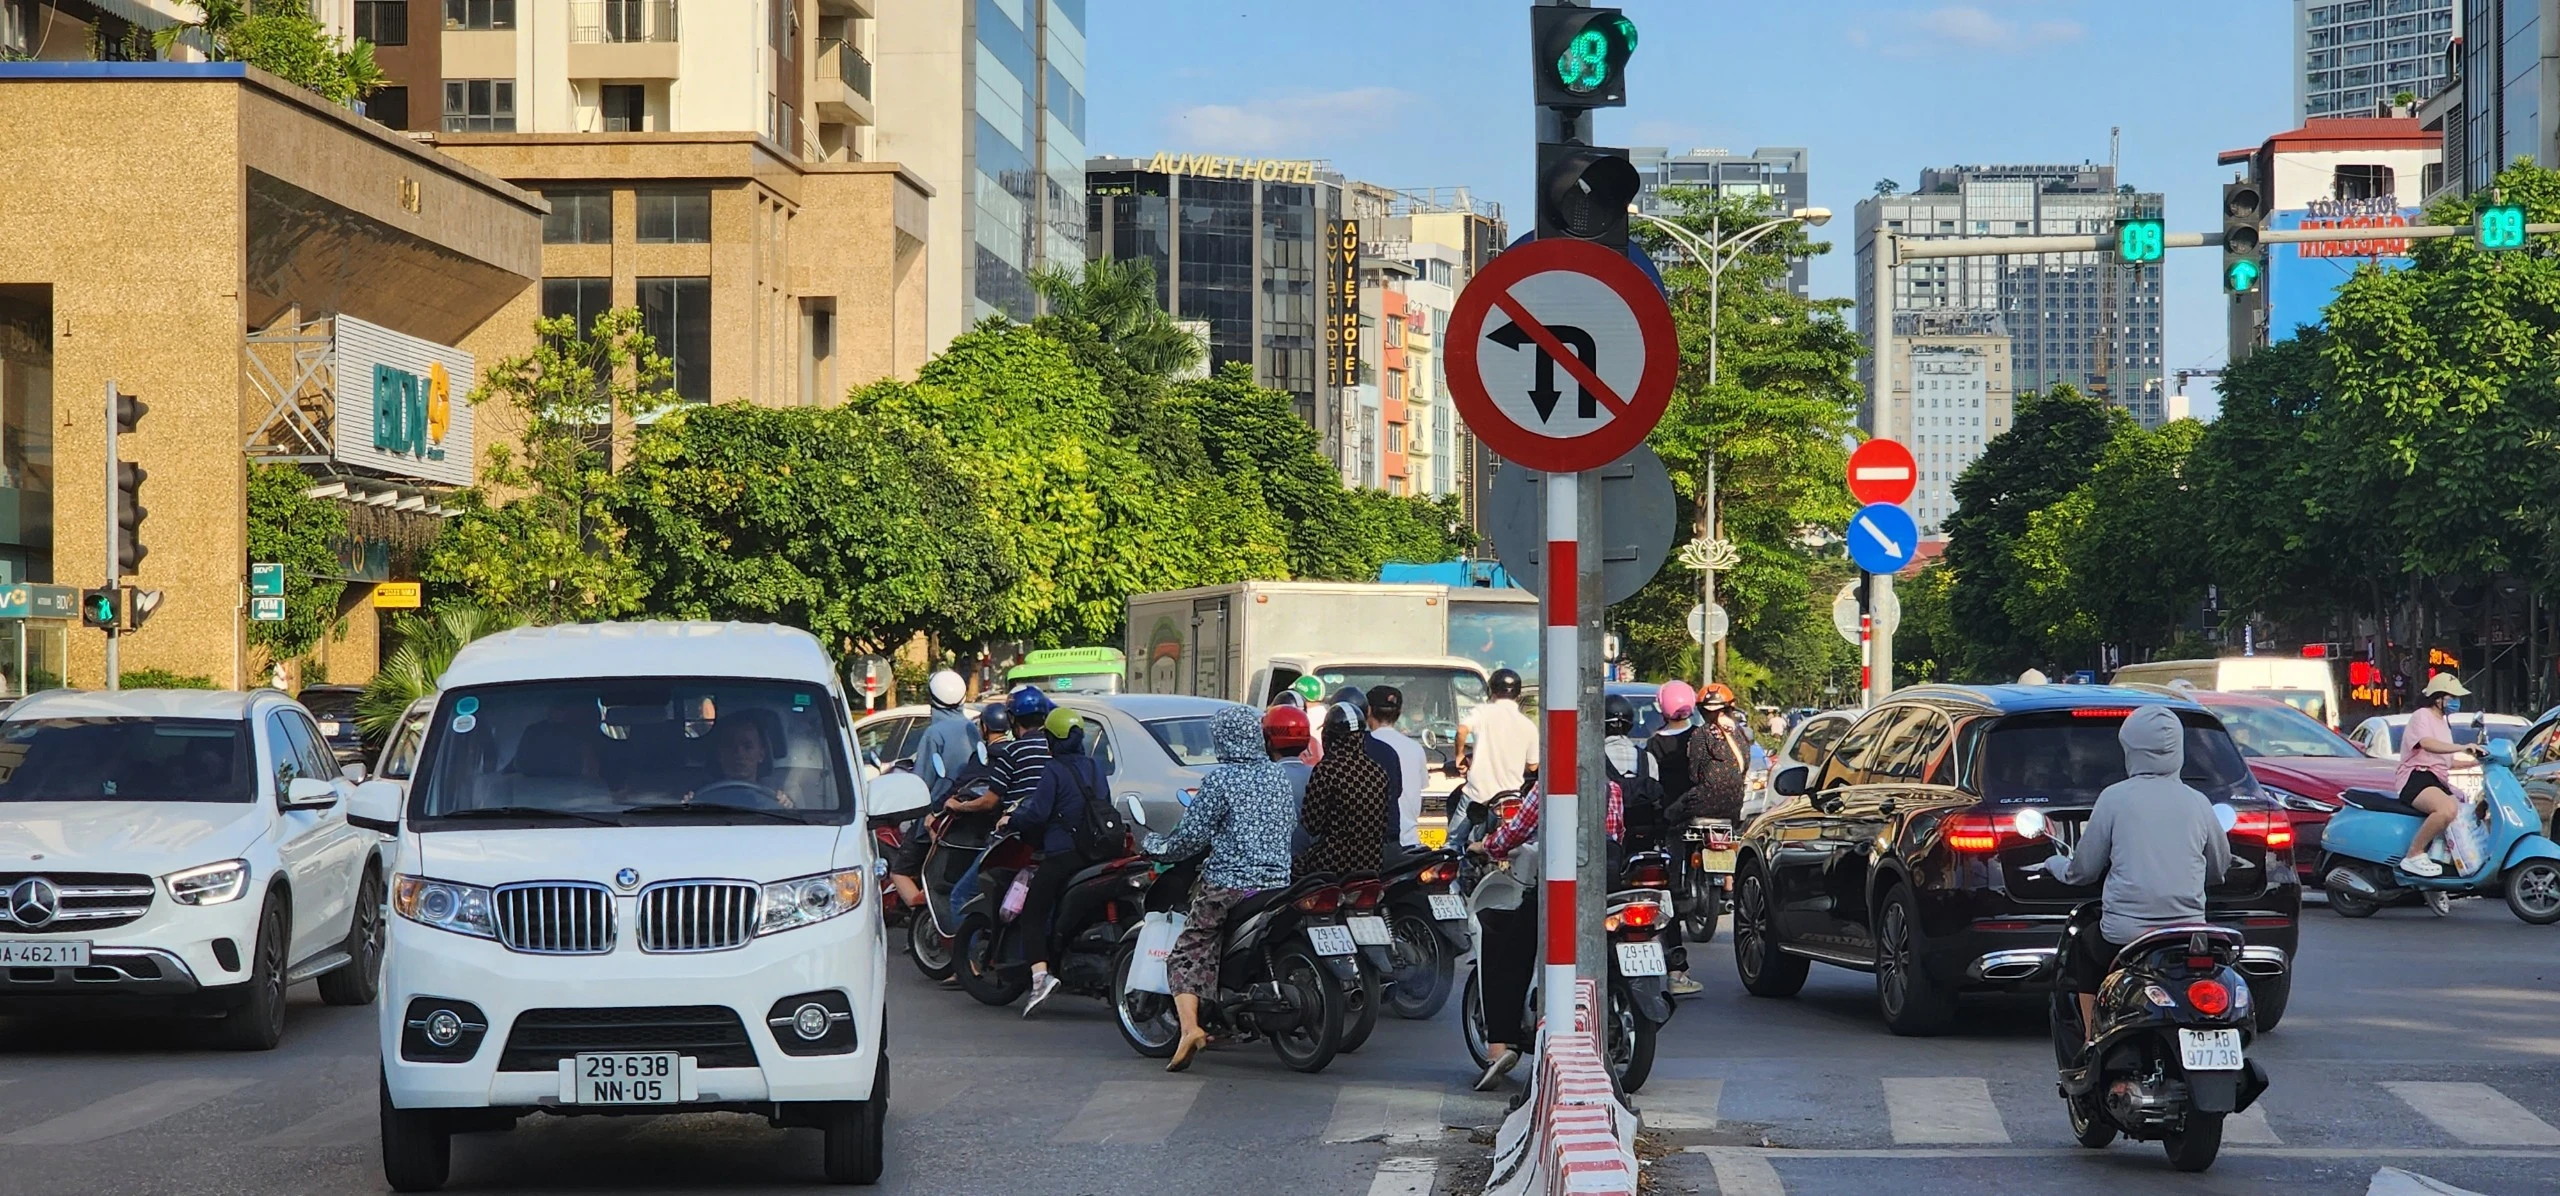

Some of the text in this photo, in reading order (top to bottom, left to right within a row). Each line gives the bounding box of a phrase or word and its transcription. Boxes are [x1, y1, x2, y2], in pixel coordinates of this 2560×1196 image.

[1147, 151, 1317, 184] AUVIET HOTEL
[2483, 209, 2522, 247] 09
[2123, 223, 2161, 260] 09
[1343, 221, 1358, 386] AUVIET HOTEL
[258, 600, 278, 610] ATM
[1315, 928, 1345, 940] 29-E1
[0, 947, 77, 962] A-462.11
[1318, 940, 1354, 954] 464.20
[1624, 944, 1656, 959] 29-F1
[1624, 959, 1664, 974] 441.40
[2189, 1032, 2230, 1048] 29-AB
[2187, 1049, 2239, 1066] 977.36
[586, 1056, 669, 1077] 29-638
[594, 1081, 662, 1101] NN-05
